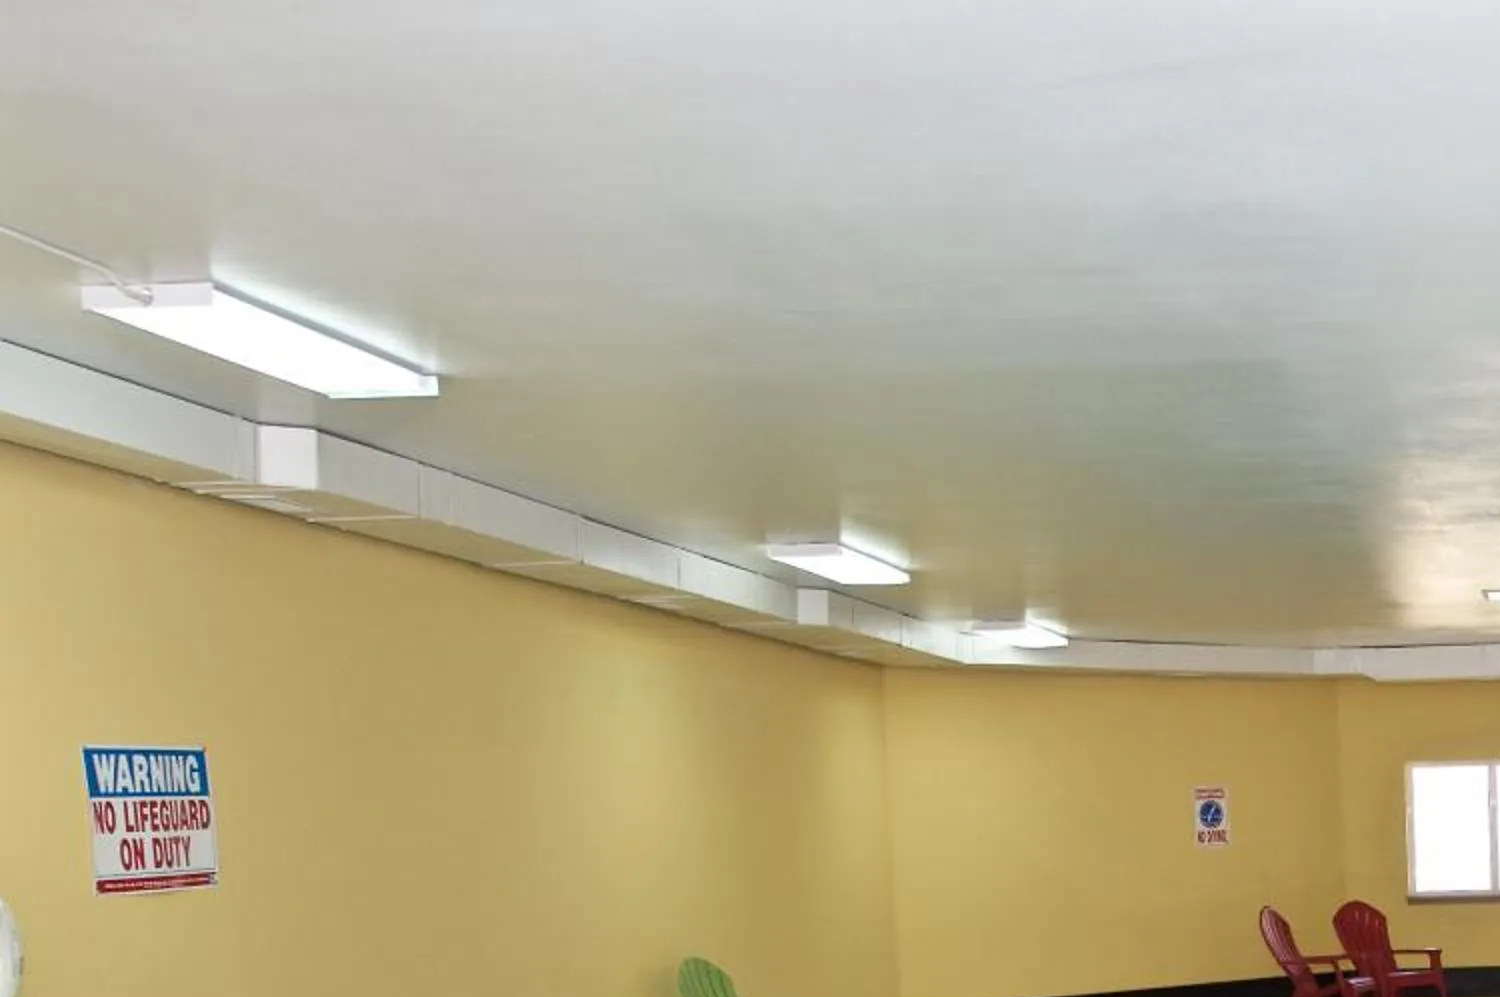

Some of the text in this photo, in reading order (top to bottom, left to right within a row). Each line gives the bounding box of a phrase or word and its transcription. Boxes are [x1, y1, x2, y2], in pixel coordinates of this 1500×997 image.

[92, 753, 201, 794] WARNING
[93, 800, 211, 835] NO LIFEGUARD
[119, 836, 191, 871] ON DUTY
